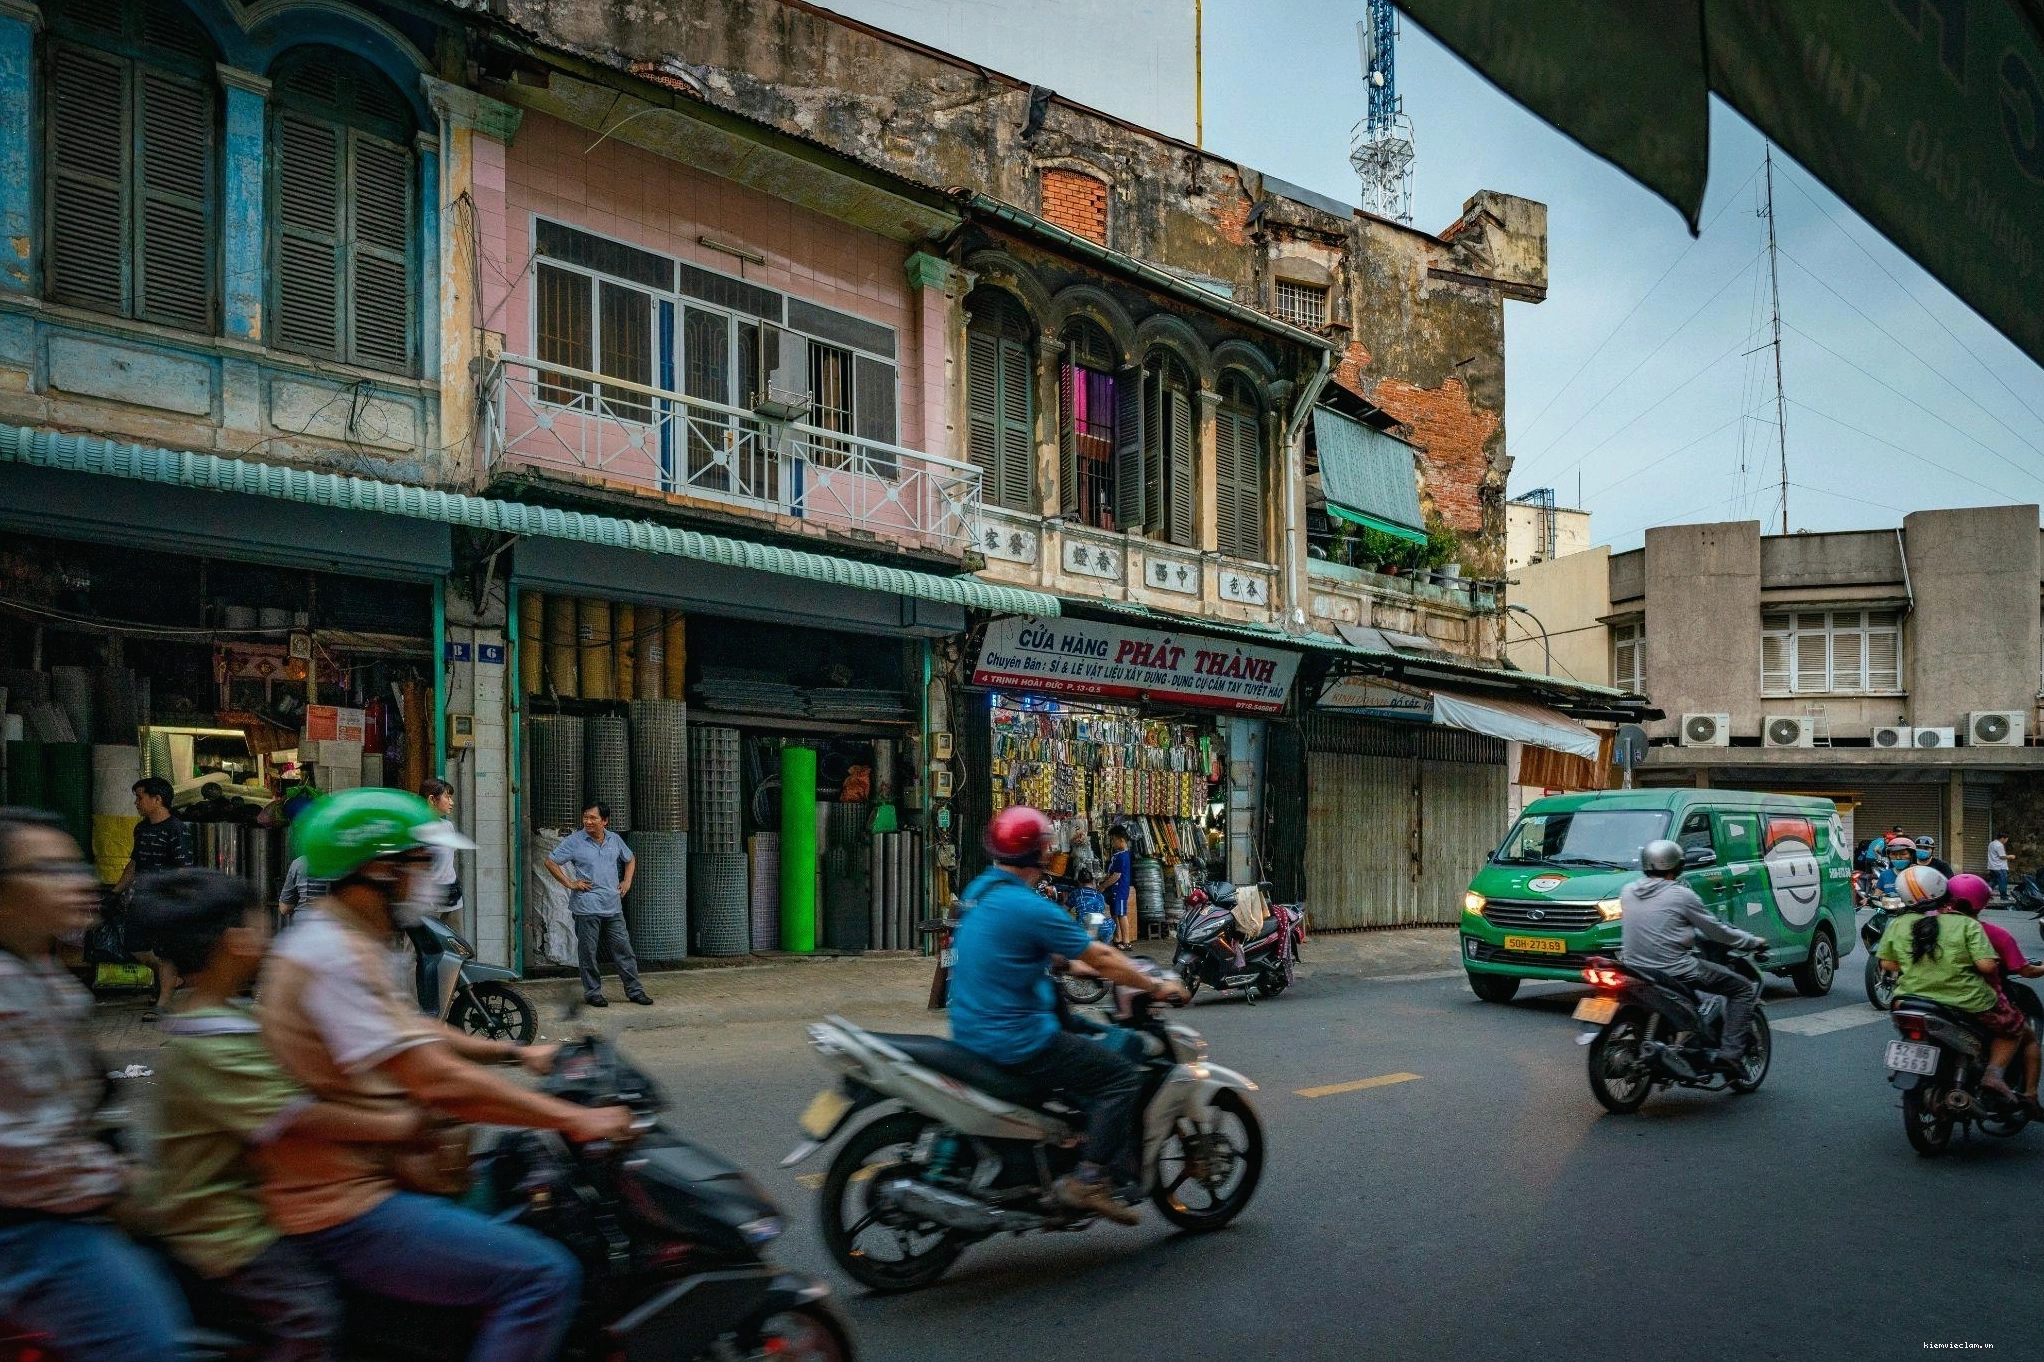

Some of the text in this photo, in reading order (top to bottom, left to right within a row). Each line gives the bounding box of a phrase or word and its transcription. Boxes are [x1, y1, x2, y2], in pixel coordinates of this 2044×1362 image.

[486, 647, 497, 659] 6
[1018, 624, 1278, 683] CỬA HÀNG PHÁT THÀNH
[981, 674, 989, 682] 4
[990, 675, 1019, 685] TRỊNH
[1020, 678, 1043, 687] HOÀI
[1045, 680, 1064, 690] ĐỨC
[986, 651, 1021, 669] Chuyên
[1061, 661, 1069, 674] &
[1086, 662, 1103, 680] VẬT
[1104, 664, 1124, 683] LIỆU
[1124, 666, 1143, 682] XÂY
[1195, 677, 1208, 693] CỤ
[1227, 681, 1243, 694] TAY
[1244, 682, 1269, 699] TUYỆT
